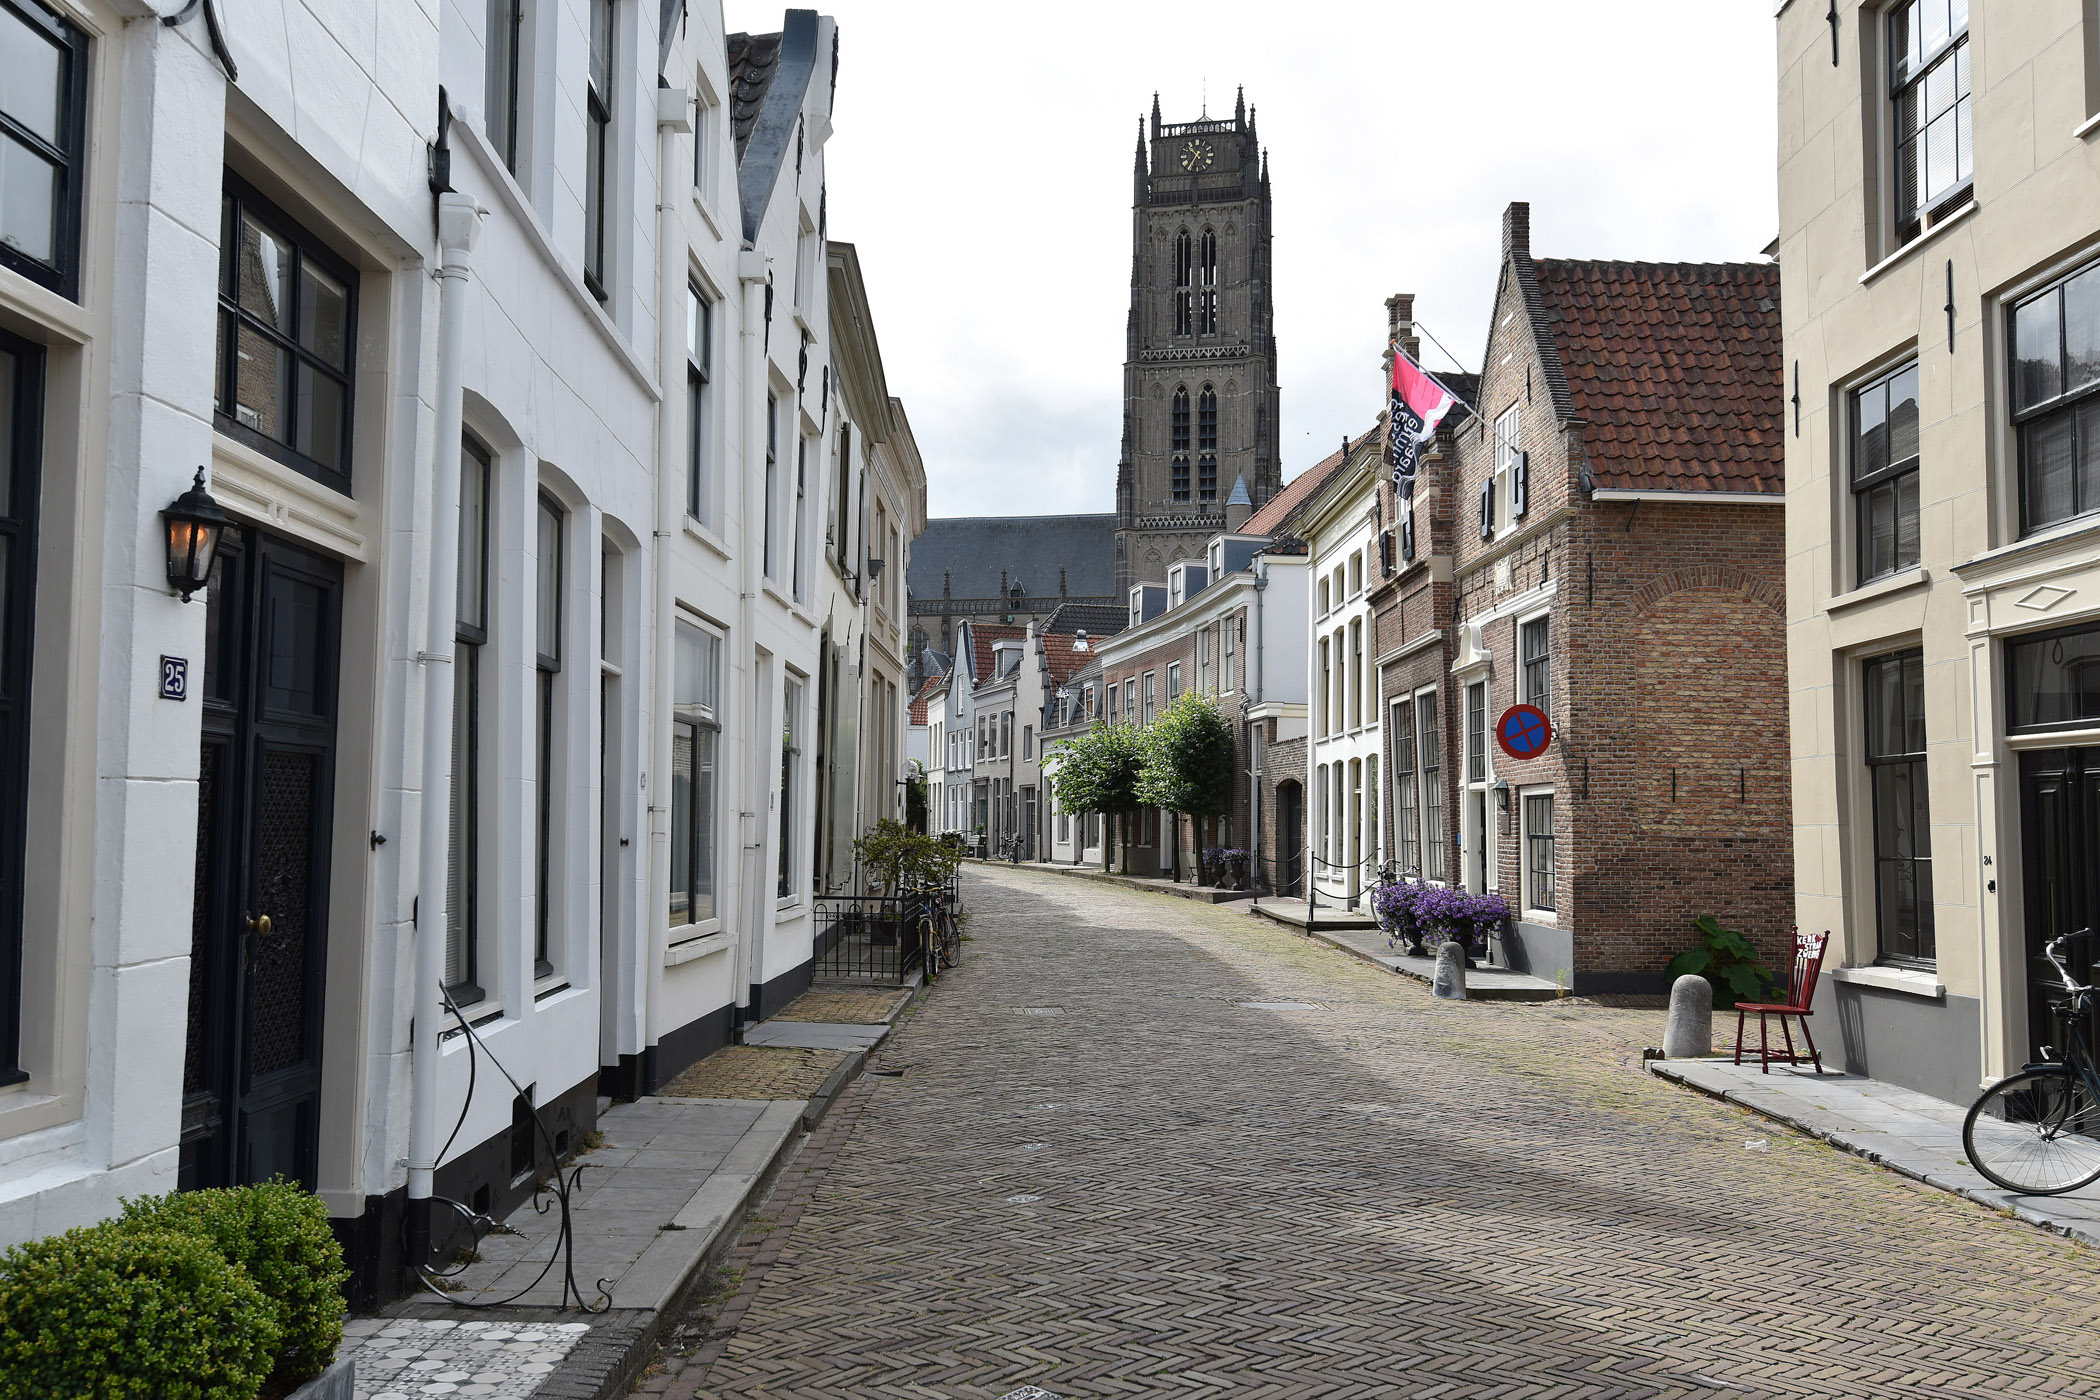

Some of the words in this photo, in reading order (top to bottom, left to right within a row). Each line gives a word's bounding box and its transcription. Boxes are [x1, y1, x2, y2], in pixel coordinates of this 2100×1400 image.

[165, 663, 184, 693] 25
[1983, 855, 1993, 866] 24
[1797, 934, 1816, 945] KERK
